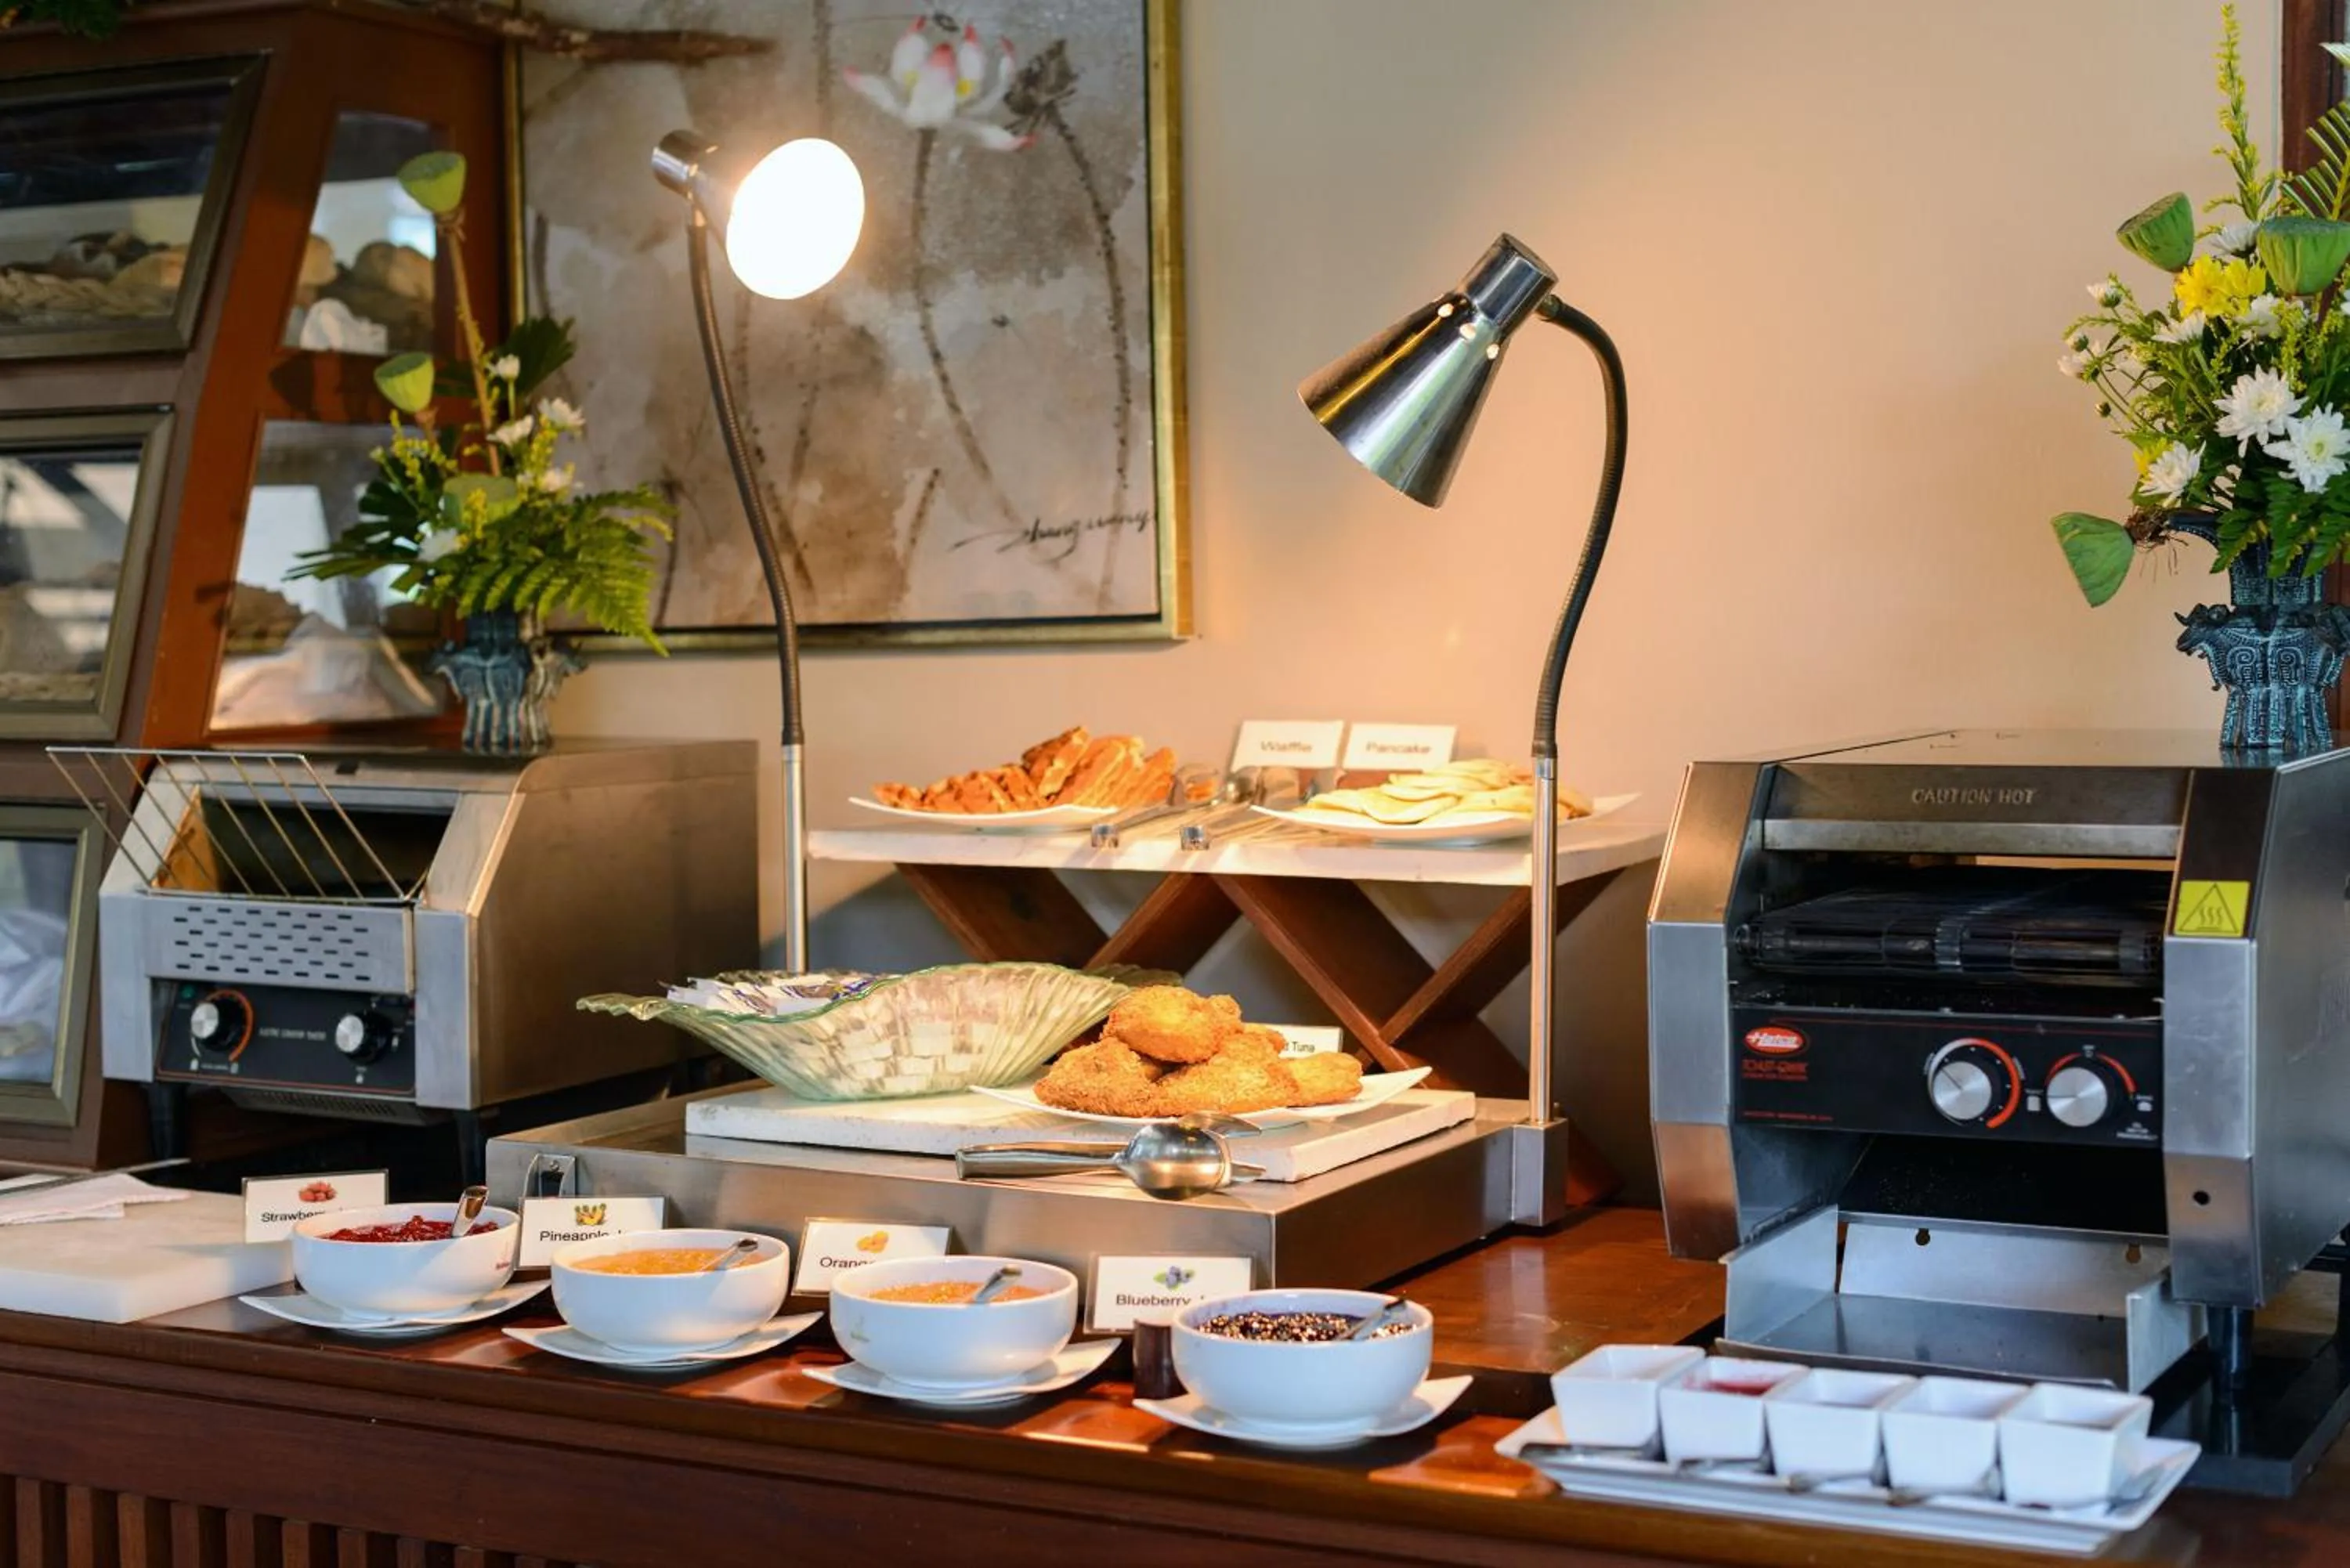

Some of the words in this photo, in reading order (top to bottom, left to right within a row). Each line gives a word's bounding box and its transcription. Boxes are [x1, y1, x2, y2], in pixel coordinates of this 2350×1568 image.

[1911, 787, 1992, 804] CAUTION
[1998, 788, 2035, 804] HOT
[1291, 1041, 1315, 1053] Tuna
[261, 1210, 326, 1223] Strawbe
[819, 1256, 877, 1268] Oran
[1115, 1294, 1191, 1306] Blueberry
